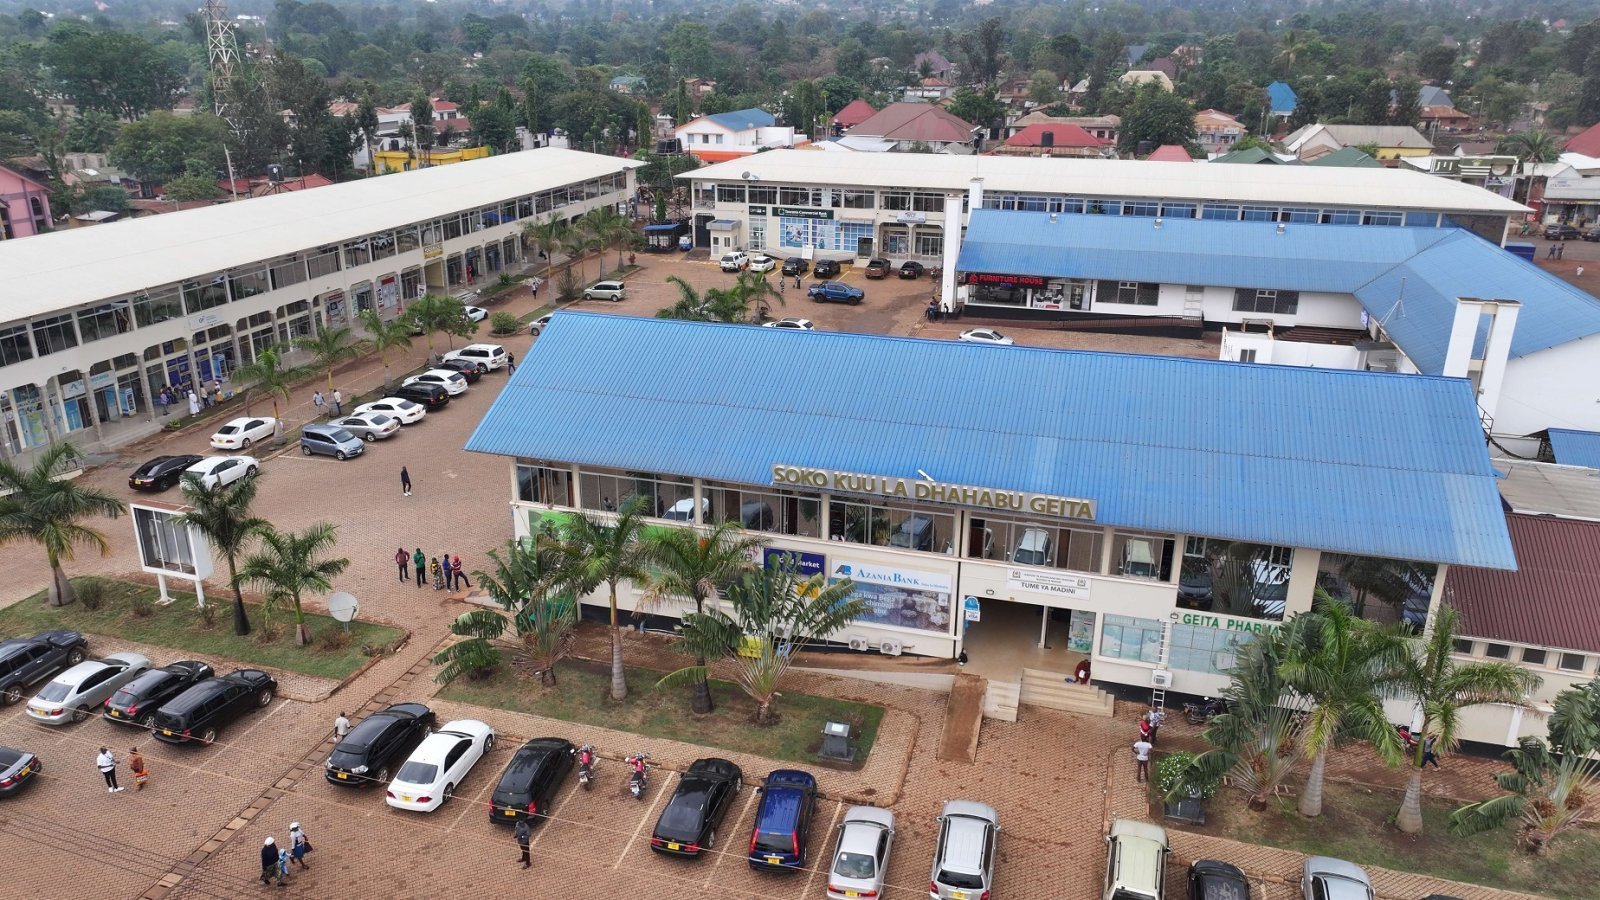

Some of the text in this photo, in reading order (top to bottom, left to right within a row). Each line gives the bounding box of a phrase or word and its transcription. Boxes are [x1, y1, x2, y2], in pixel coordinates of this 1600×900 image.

[979, 274, 1044, 285] FURNITURE HOUSE
[774, 466, 1093, 519] SOKO KUU LA DHAHABU GEITA
[798, 560, 820, 568] arket
[857, 569, 892, 582] AZANIA
[893, 572, 920, 586] BANK
[1021, 582, 1040, 590] TUME
[1050, 586, 1076, 594] MADINI
[1183, 613, 1219, 628] GEITA
